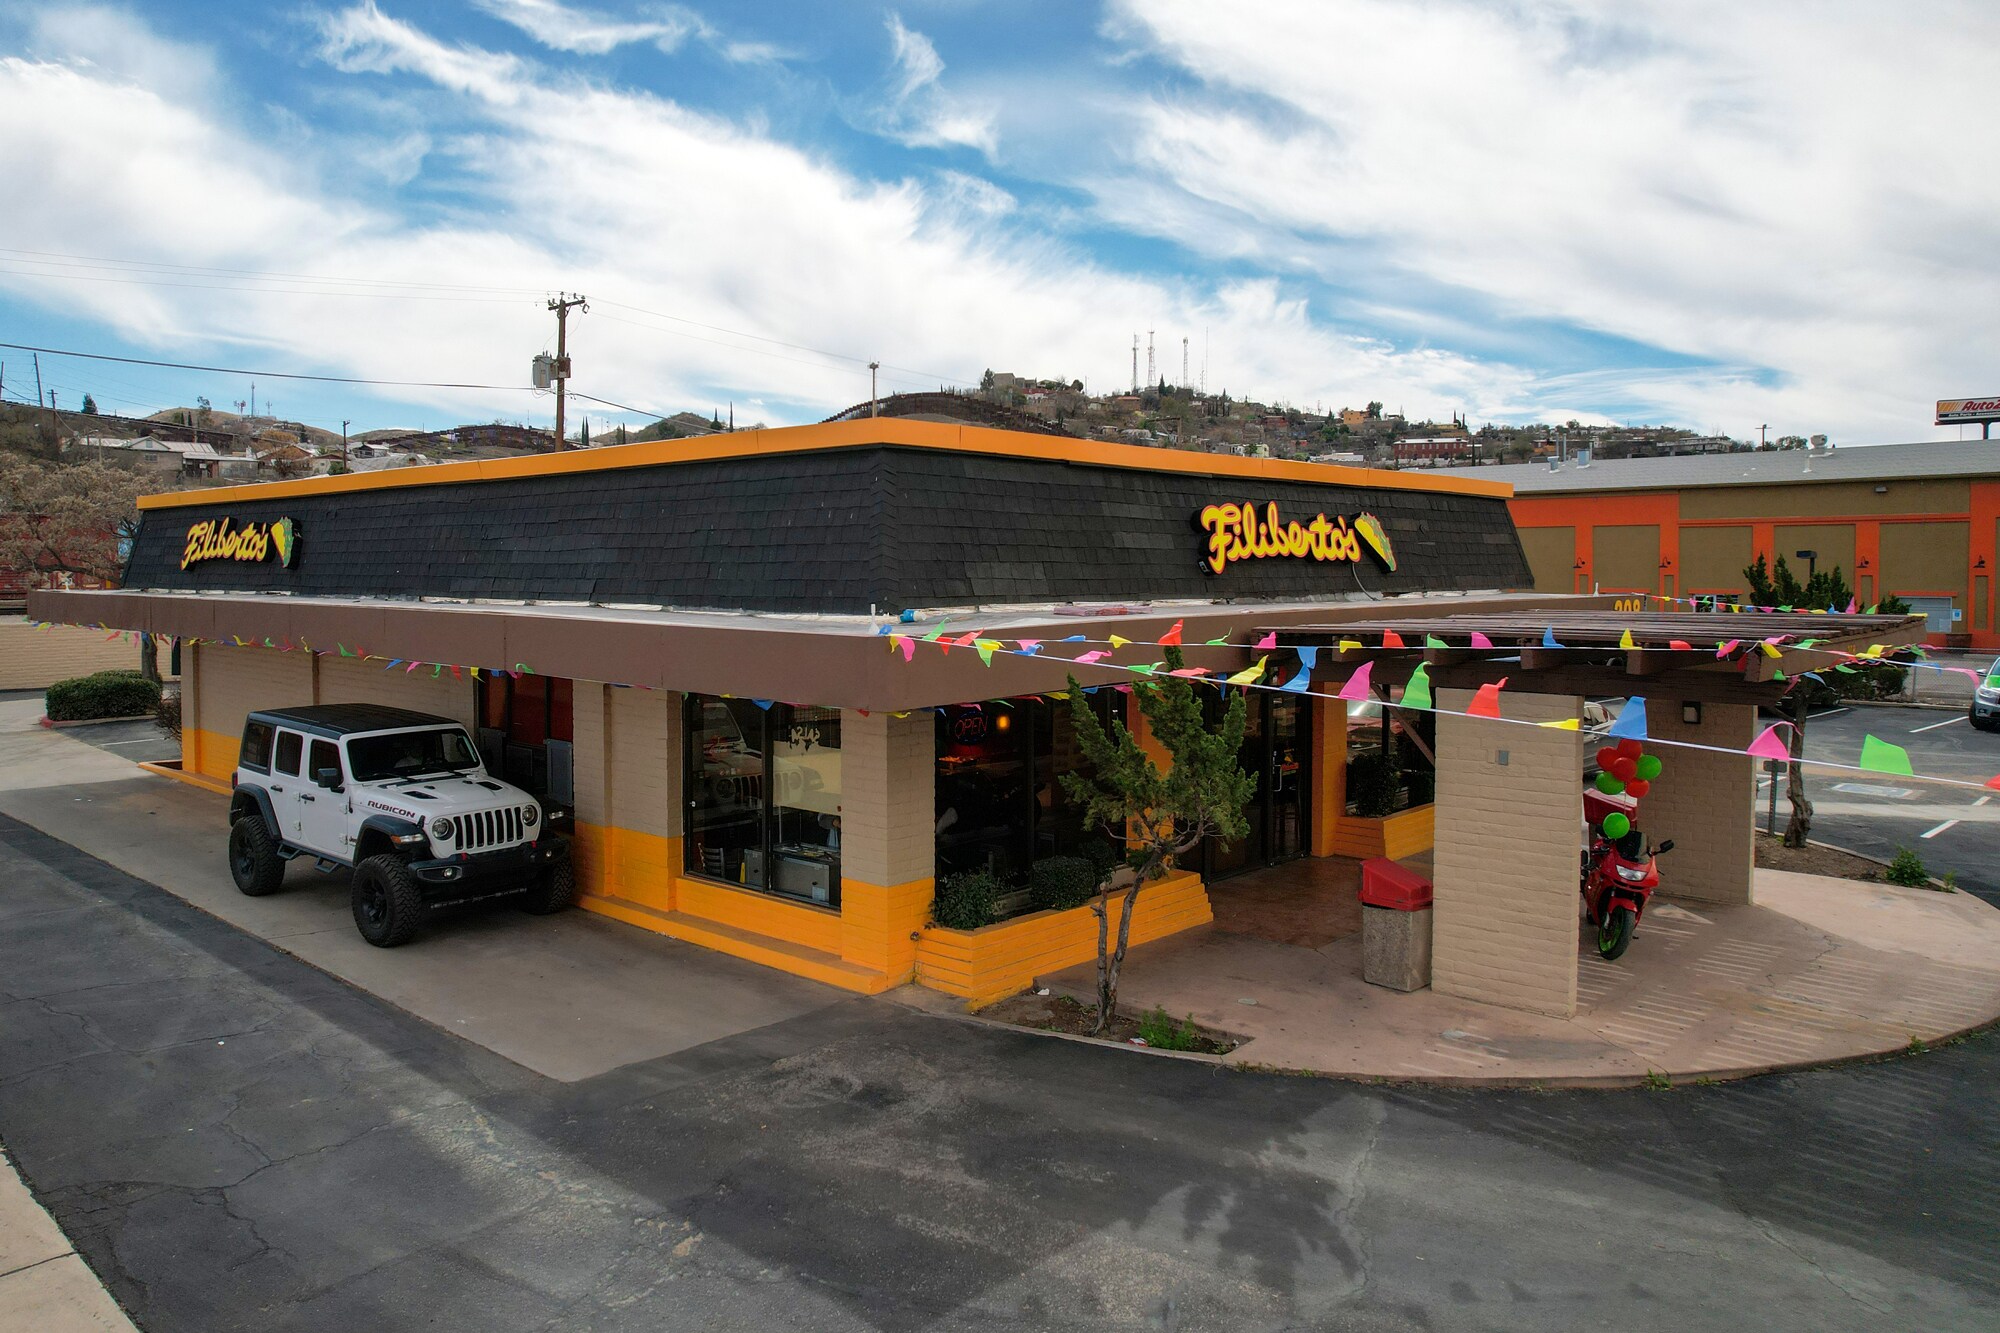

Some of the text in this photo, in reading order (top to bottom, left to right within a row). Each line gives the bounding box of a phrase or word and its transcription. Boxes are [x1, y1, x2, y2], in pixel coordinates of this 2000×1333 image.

[182, 517, 269, 570] Filiberto's
[1201, 501, 1361, 574] Filiberto's
[955, 715, 988, 738] OPEN
[368, 801, 416, 818] RUBICON
